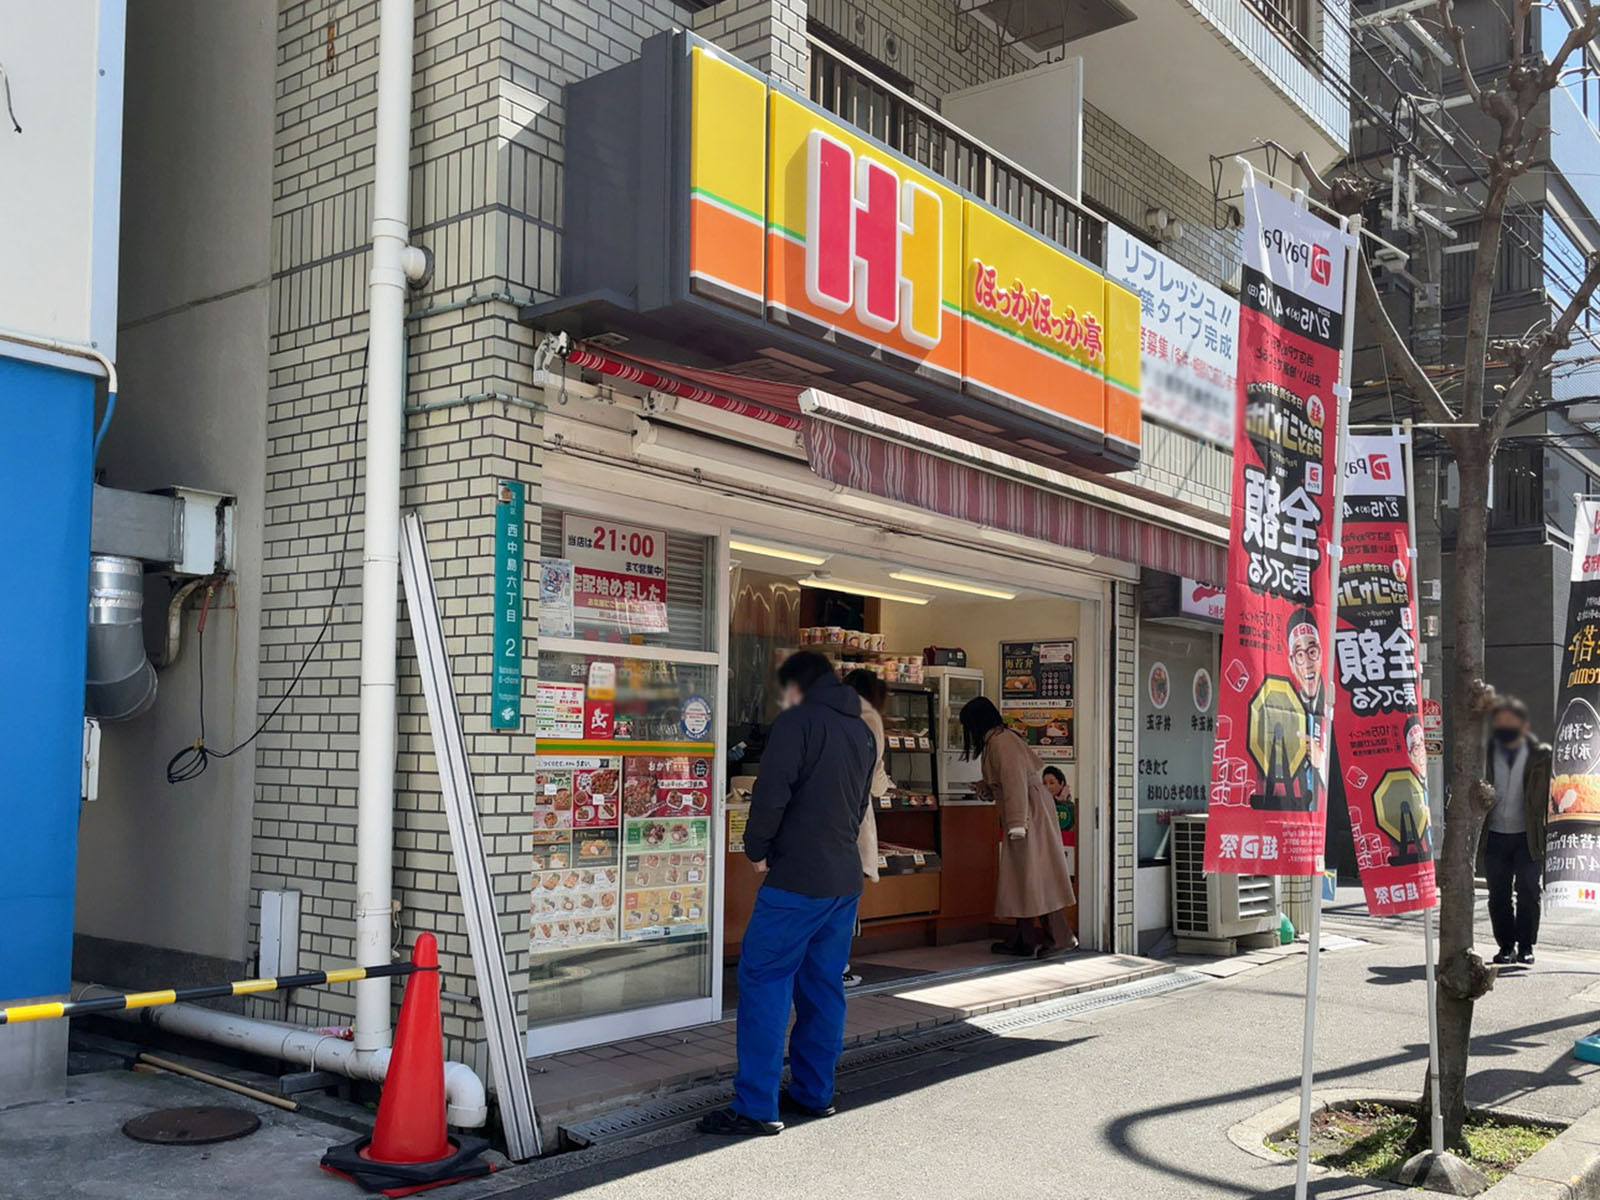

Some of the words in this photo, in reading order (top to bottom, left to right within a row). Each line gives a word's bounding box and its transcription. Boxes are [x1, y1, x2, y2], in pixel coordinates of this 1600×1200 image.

[972, 257, 1103, 361] ほっかほっか亭
[568, 535, 593, 548] 当店は
[593, 526, 655, 558] 21:00
[506, 523, 519, 623] 西中島六丁目
[505, 638, 516, 657] 2
[1138, 759, 1169, 776] できたて
